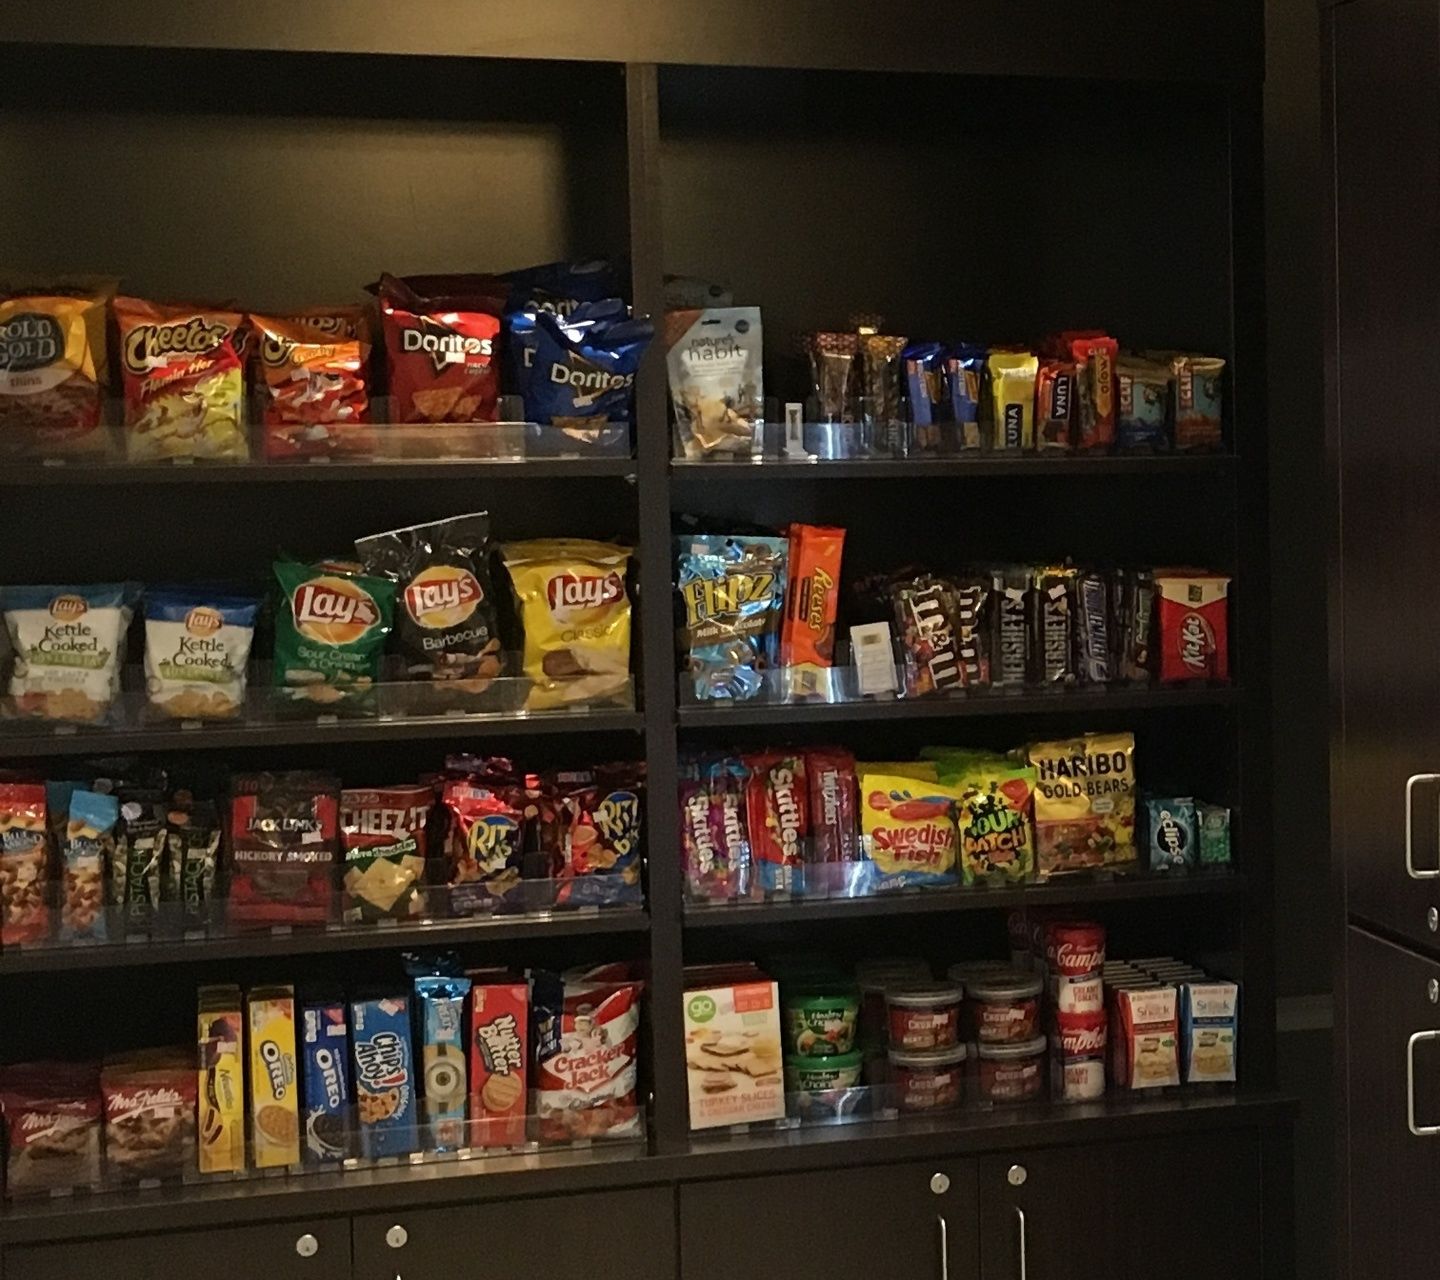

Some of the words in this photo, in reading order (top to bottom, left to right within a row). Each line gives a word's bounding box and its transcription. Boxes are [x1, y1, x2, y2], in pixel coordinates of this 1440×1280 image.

[125, 318, 229, 373] Cheetos
[404, 329, 492, 355] Doritos
[688, 344, 743, 361] habit
[551, 363, 634, 389] Doritos
[1056, 376, 1068, 417] LUNA
[1008, 407, 1019, 448] LUNA
[414, 574, 472, 617] Lay's
[554, 575, 617, 610] Lay's
[684, 573, 774, 626] Flipz
[38, 637, 98, 654] Cooked
[44, 623, 92, 640] Kettle
[179, 636, 225, 653] Kettle
[422, 625, 488, 651] Barbecue
[172, 650, 230, 668] Cooked
[1039, 750, 1128, 780] HARIBO
[770, 766, 801, 858] Skittles
[688, 795, 715, 874] Skittles
[871, 823, 955, 852] Swedish
[1160, 809, 1184, 865] eclipse
[235, 851, 283, 863] HICKORY
[286, 851, 333, 863] SMOKED
[892, 845, 941, 866] Fish
[691, 1000, 712, 1018] go
[373, 1034, 399, 1076] Chips
[479, 1023, 509, 1074] Butter
[494, 1015, 522, 1067] Nutter
[261, 1041, 286, 1099] OREO
[553, 1044, 625, 1073] Cracker
[316, 1048, 341, 1108] OREO
[563, 1064, 612, 1088] Jack
